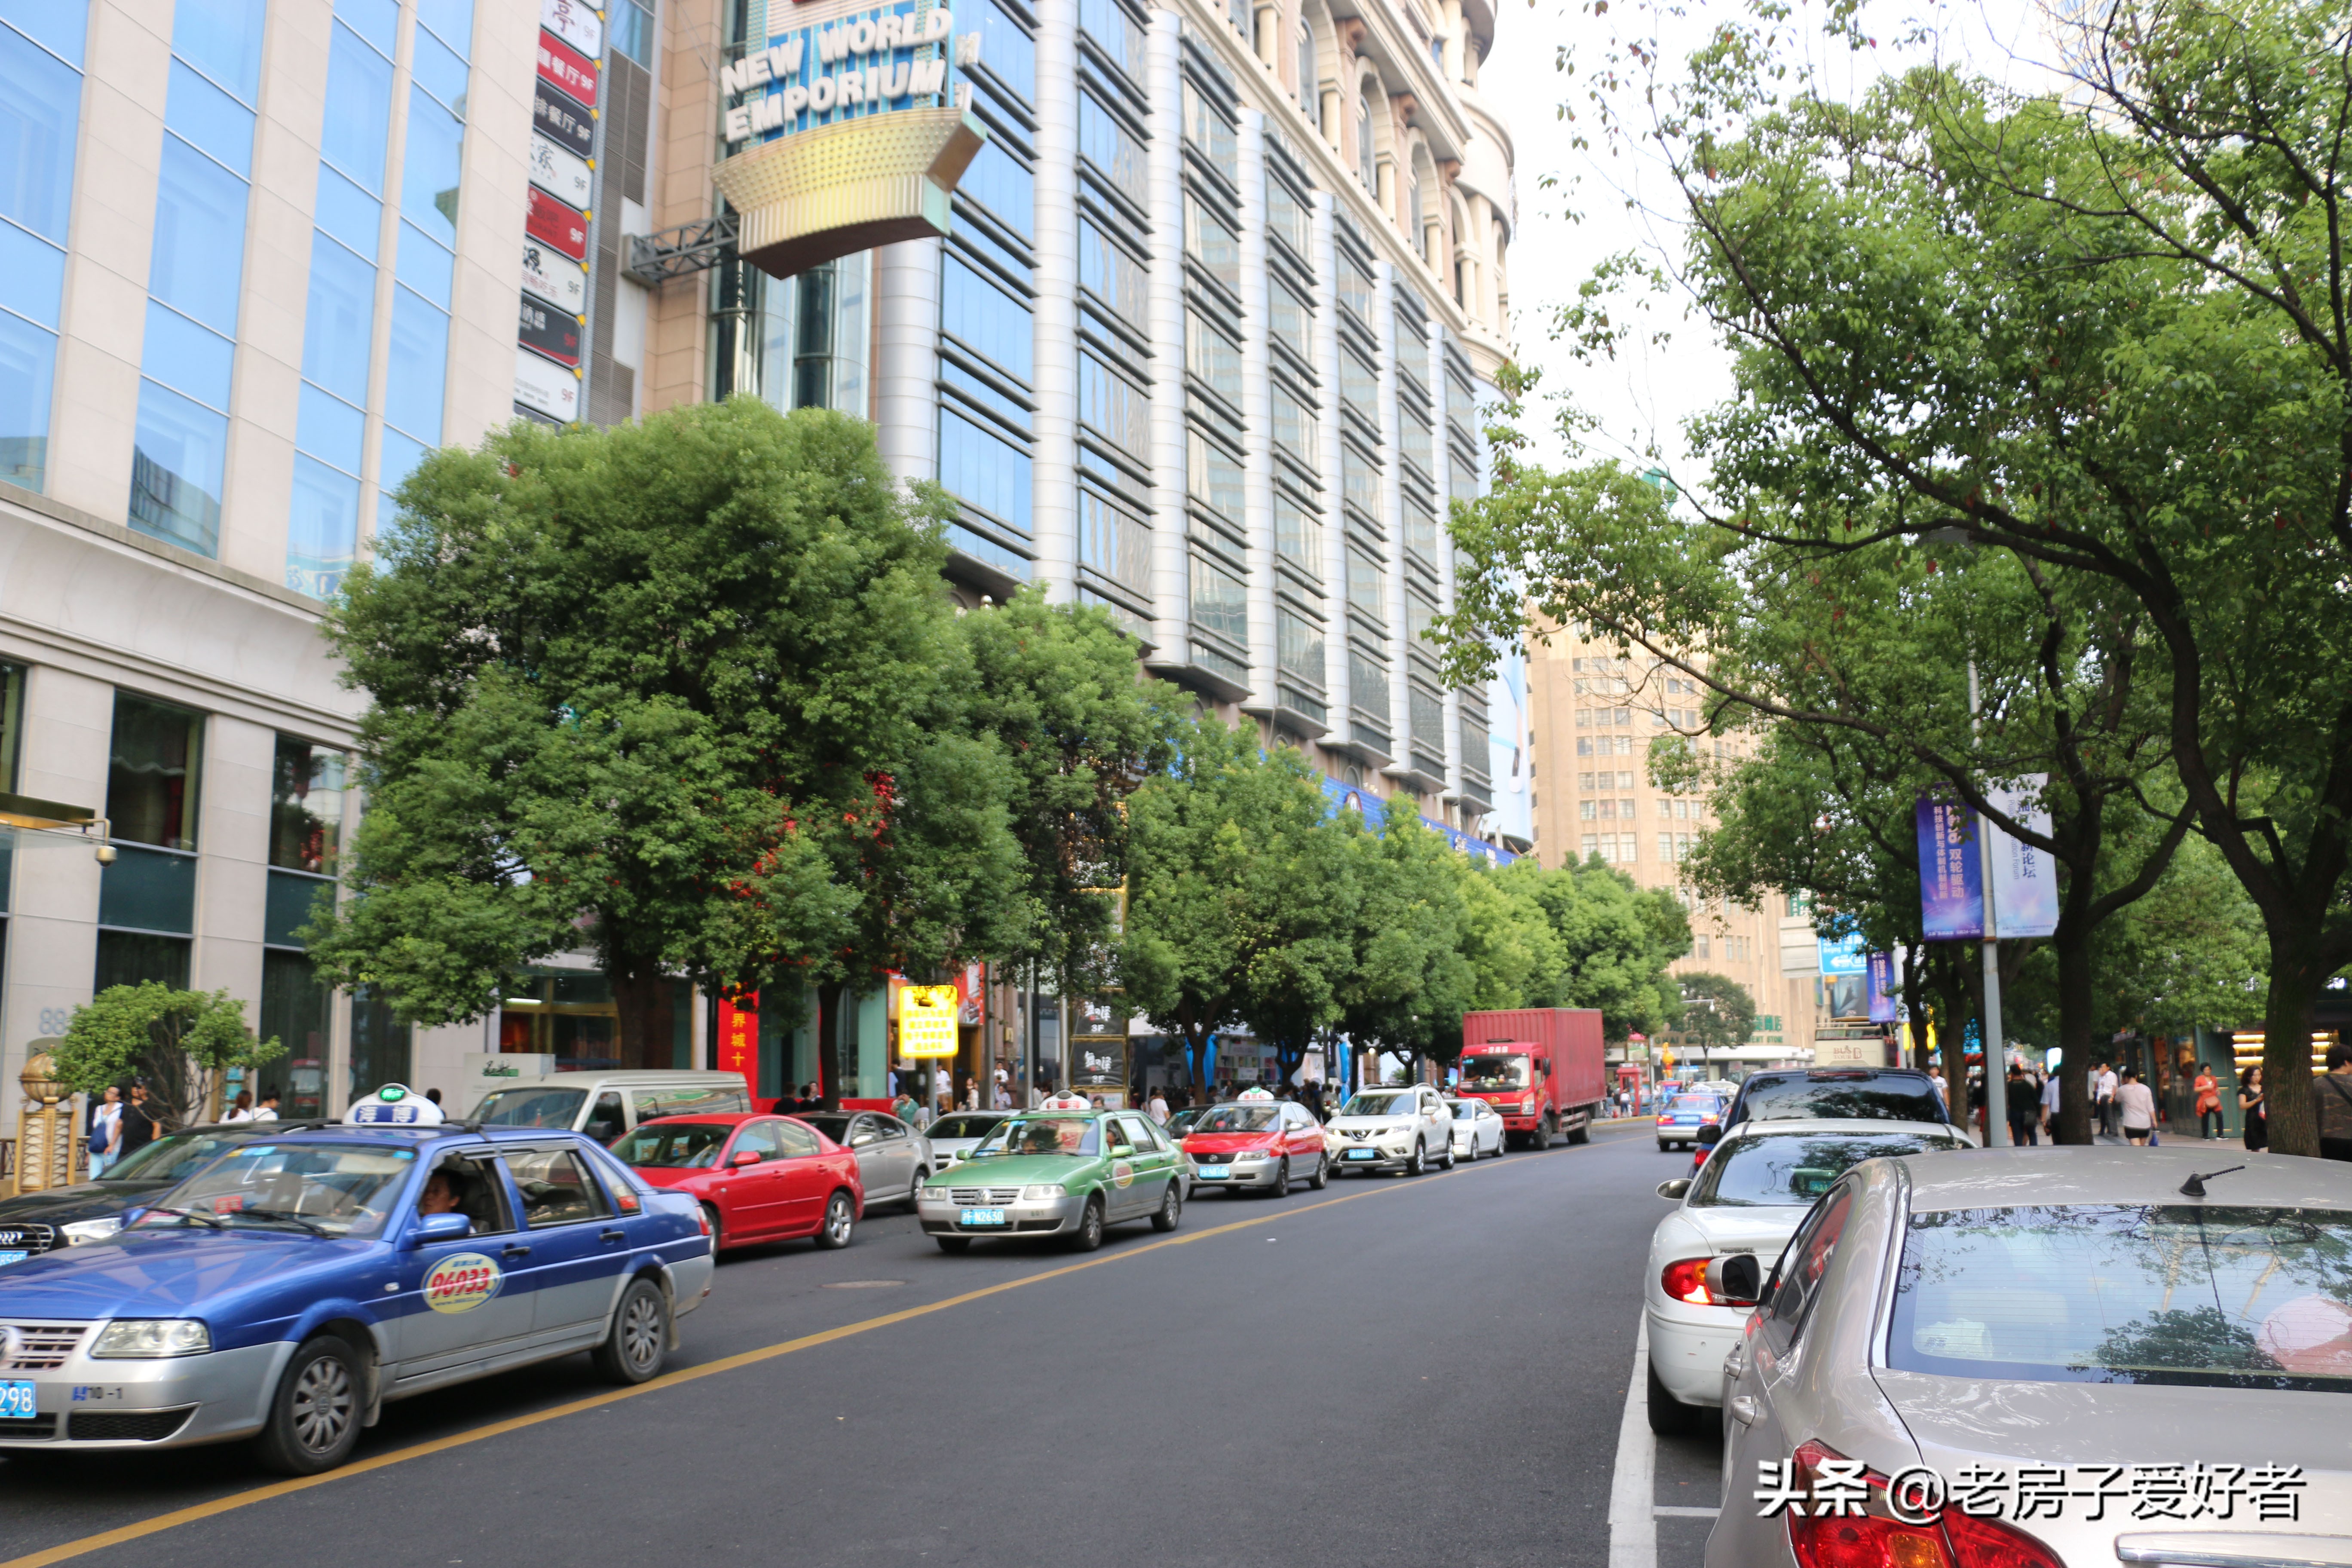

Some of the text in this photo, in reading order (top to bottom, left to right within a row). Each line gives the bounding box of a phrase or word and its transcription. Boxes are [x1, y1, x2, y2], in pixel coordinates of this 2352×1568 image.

[720, 38, 804, 97] NEW
[817, 8, 952, 63] WORLD
[726, 59, 946, 142] EMPORIUM
[577, 124, 591, 141] 9F
[573, 176, 587, 191] 9F
[570, 227, 585, 245] 9F
[567, 280, 581, 295] 9F
[564, 333, 577, 349] 9F
[561, 388, 575, 403] 9F
[1950, 848, 1965, 898] 双轮驱动
[39, 1007, 67, 1035] 88
[1092, 1075, 1105, 1083] 3F
[358, 1106, 413, 1122] 海博
[431, 1267, 490, 1298] 96933
